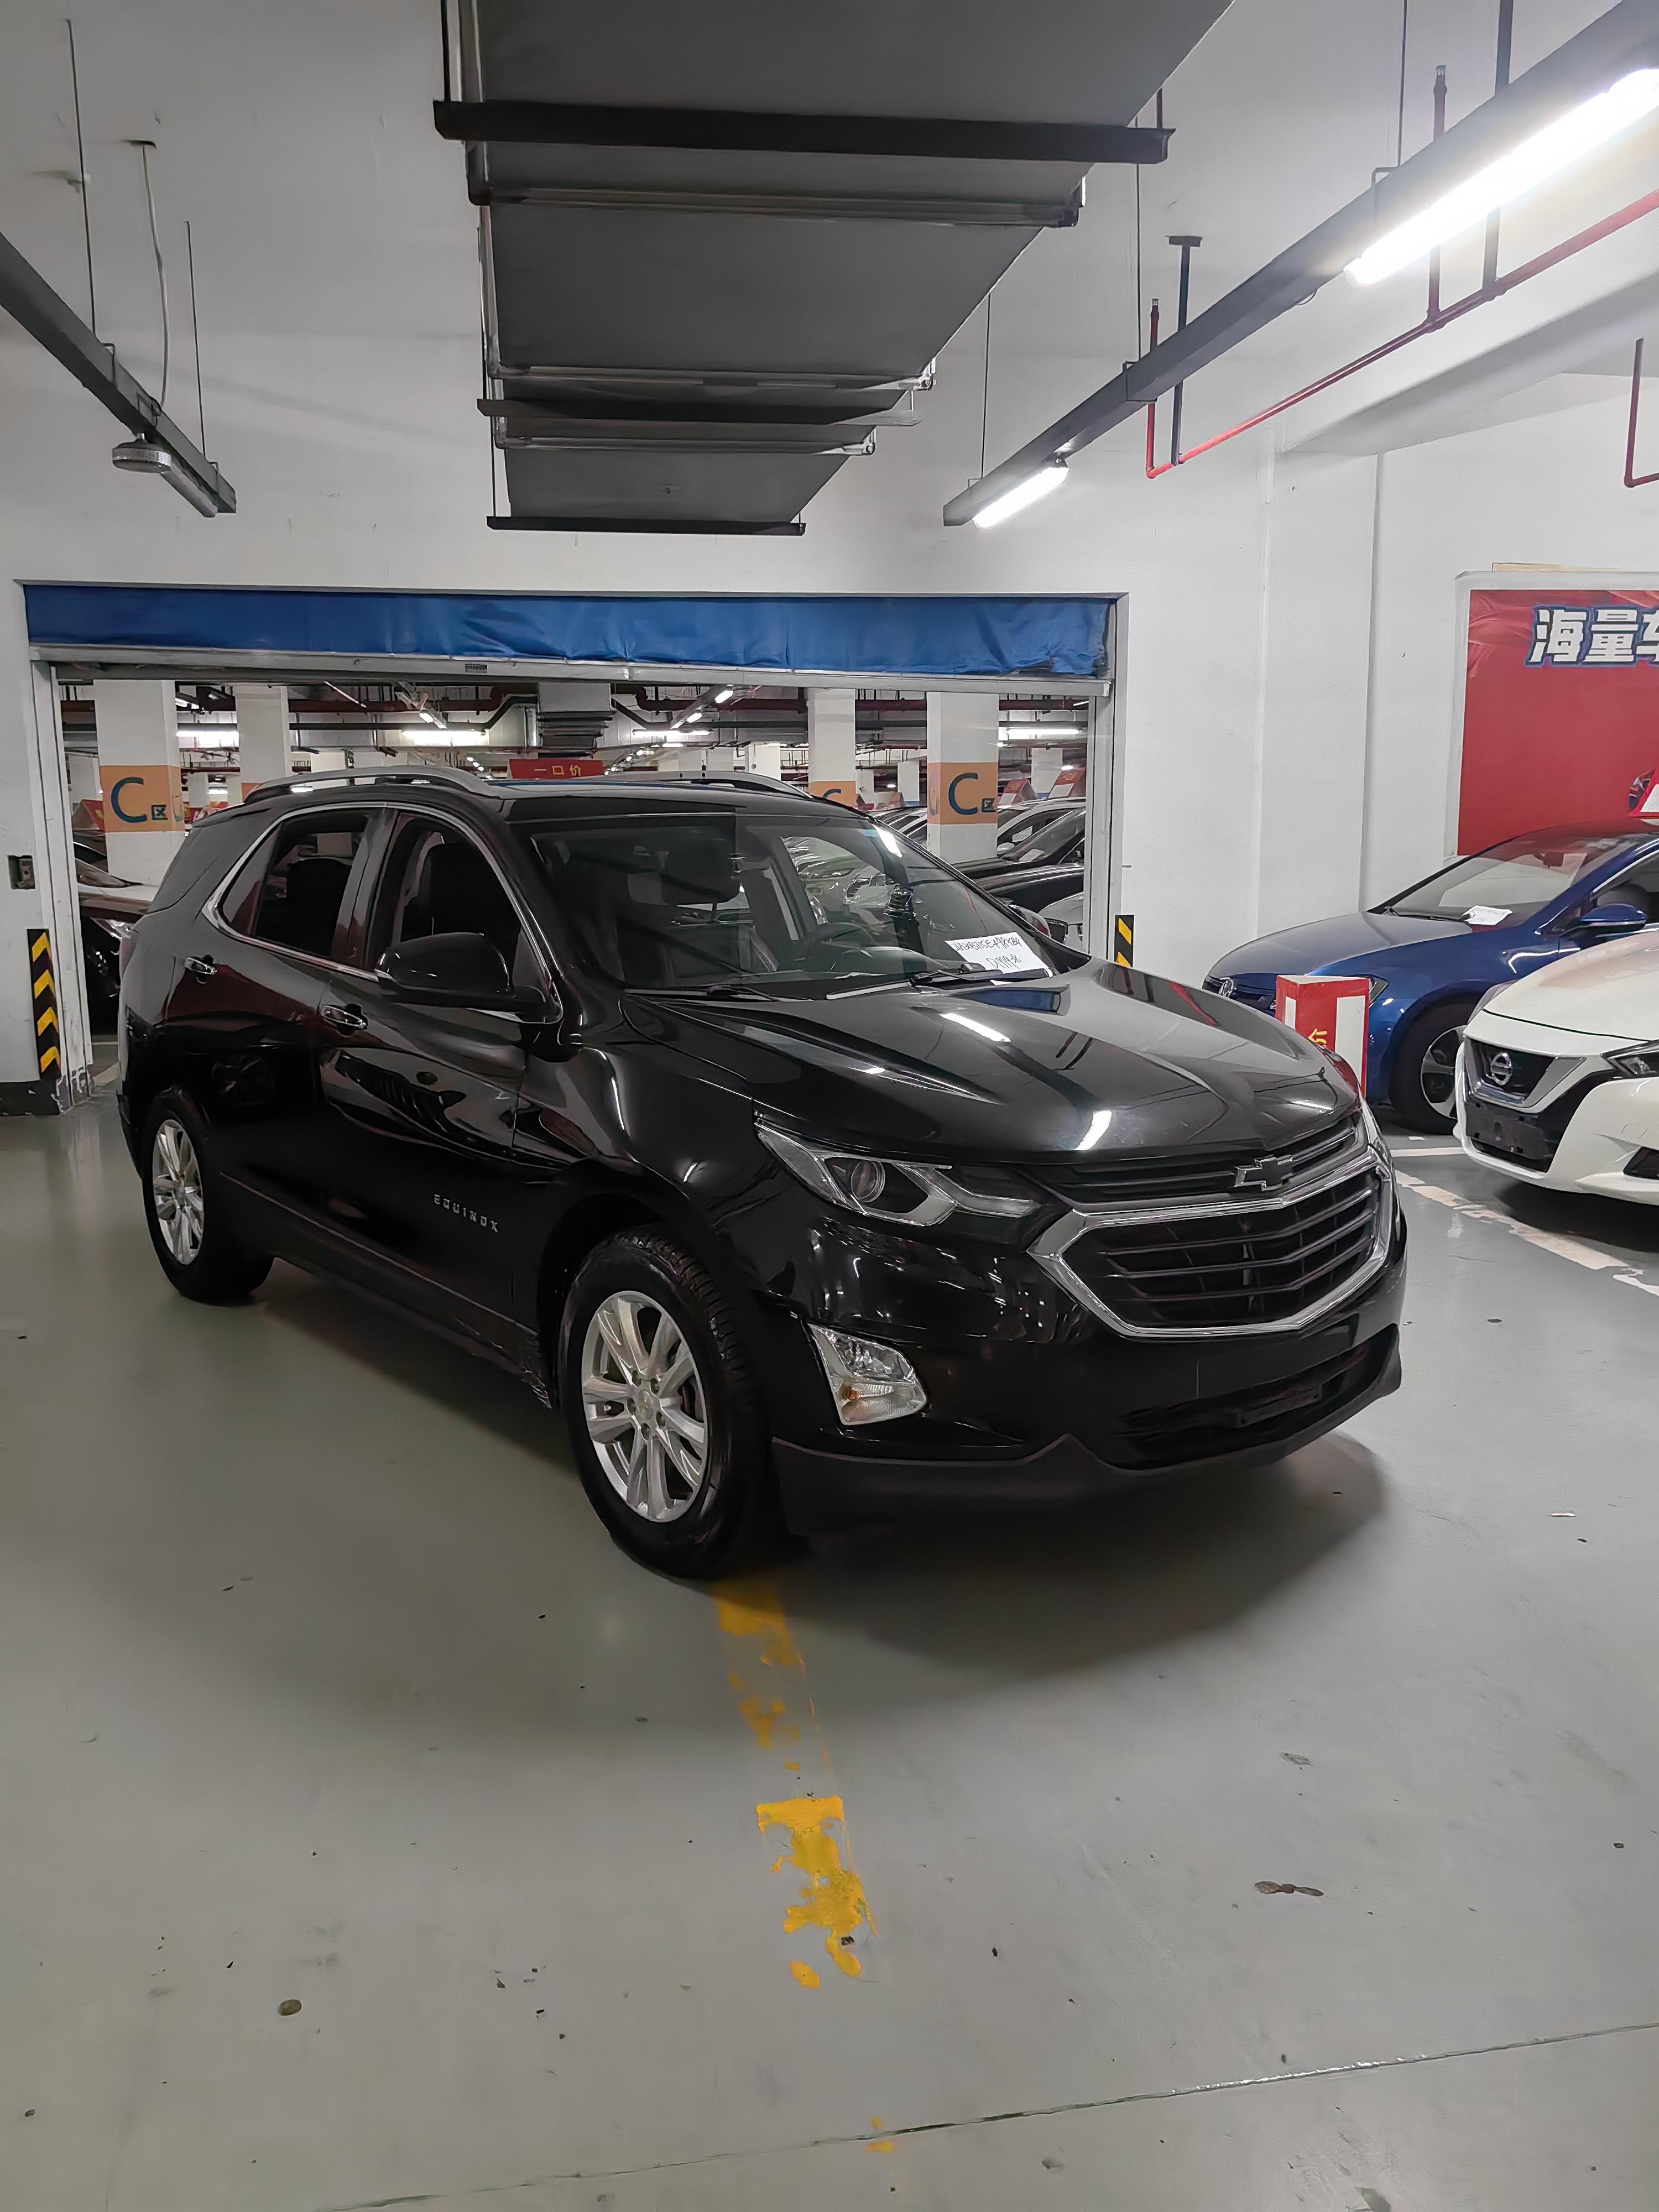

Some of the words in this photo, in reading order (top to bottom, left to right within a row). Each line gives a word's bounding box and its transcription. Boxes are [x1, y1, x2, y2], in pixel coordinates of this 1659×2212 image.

[533, 765, 581, 776] 一口价
[434, 1194, 498, 1233] EQUINOX
